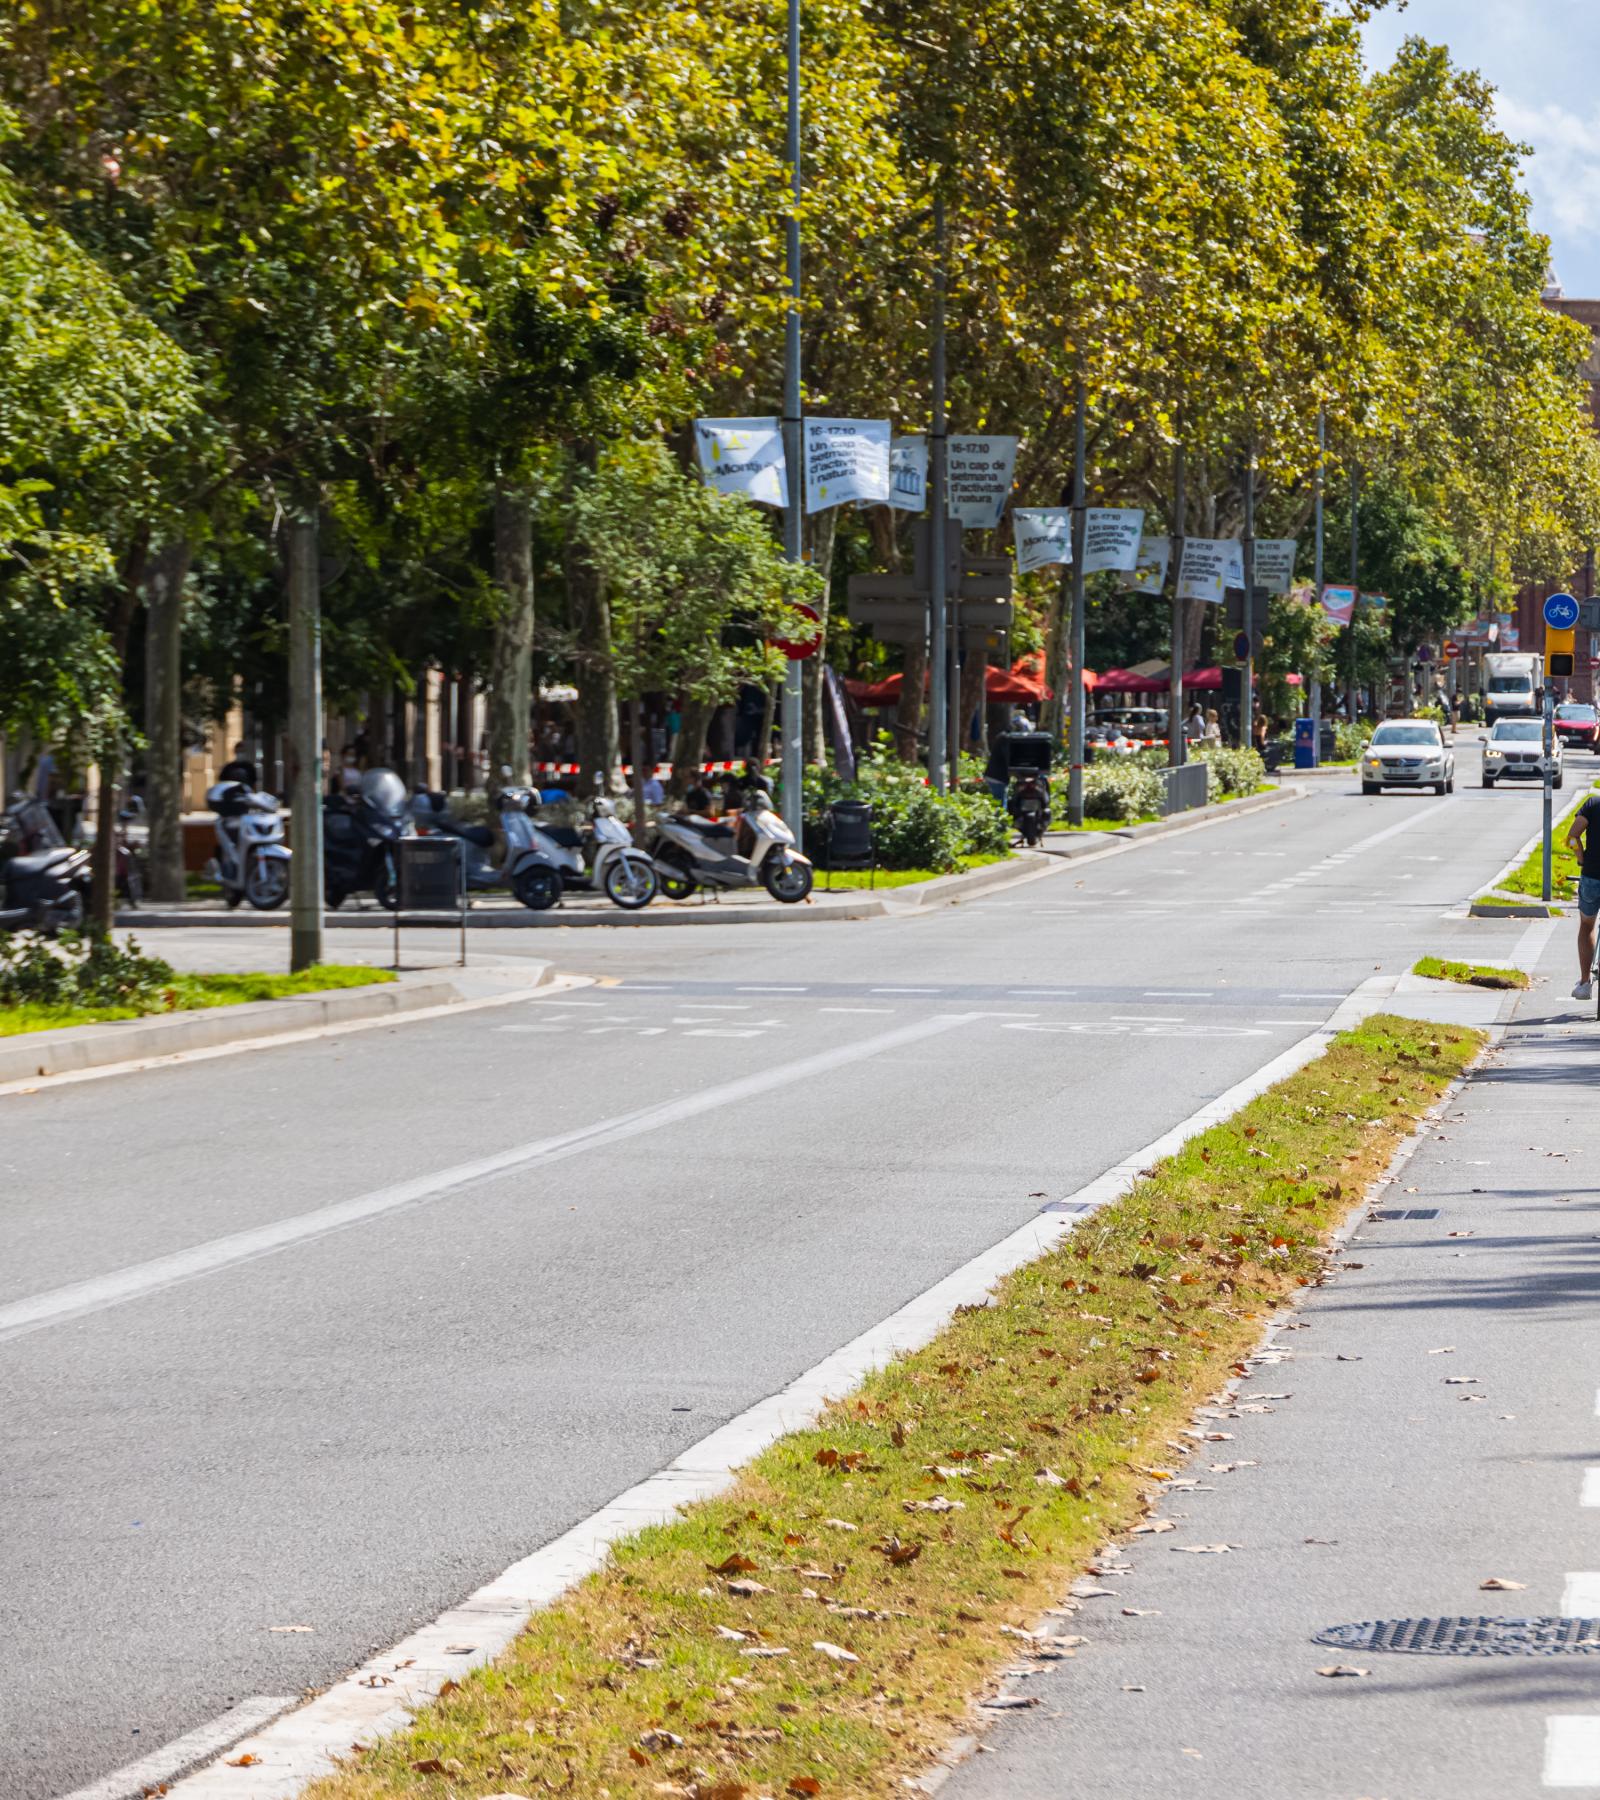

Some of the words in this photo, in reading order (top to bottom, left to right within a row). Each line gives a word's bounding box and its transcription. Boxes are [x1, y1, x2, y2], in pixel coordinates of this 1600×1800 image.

[809, 426, 857, 436] 16-17.10
[810, 441, 828, 452] Un
[951, 443, 990, 454] 16-17.10
[951, 460, 966, 470] Un
[969, 461, 990, 473] cap
[992, 460, 1006, 470] de
[817, 468, 856, 484] natura
[951, 472, 998, 481] setmana
[951, 482, 1006, 493] d'activitats
[958, 494, 993, 504] natura
